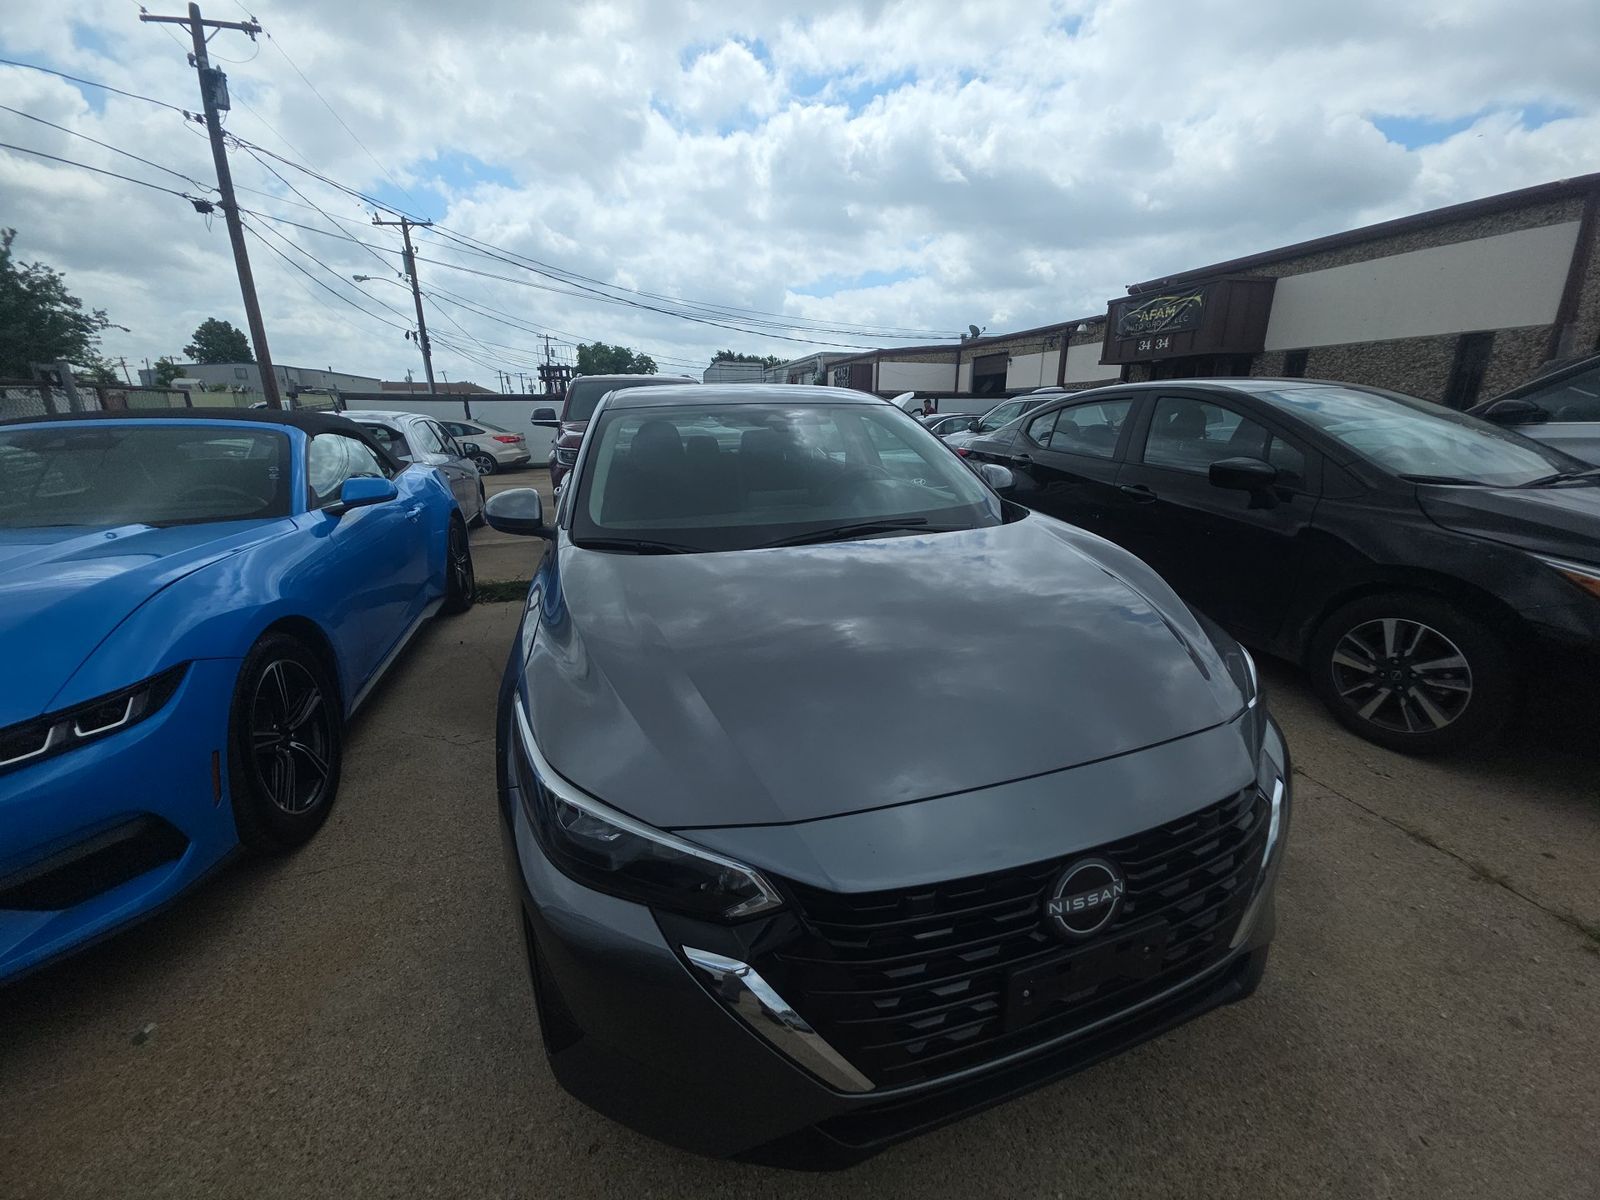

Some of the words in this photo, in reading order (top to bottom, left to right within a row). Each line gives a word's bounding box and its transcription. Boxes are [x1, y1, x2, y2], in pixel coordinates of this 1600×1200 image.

[1140, 305, 1176, 322] AFAM
[1175, 315, 1189, 324] LLC
[1138, 340, 1151, 351] 34
[1156, 337, 1169, 349] 34
[1048, 881, 1123, 914] NISSAN
